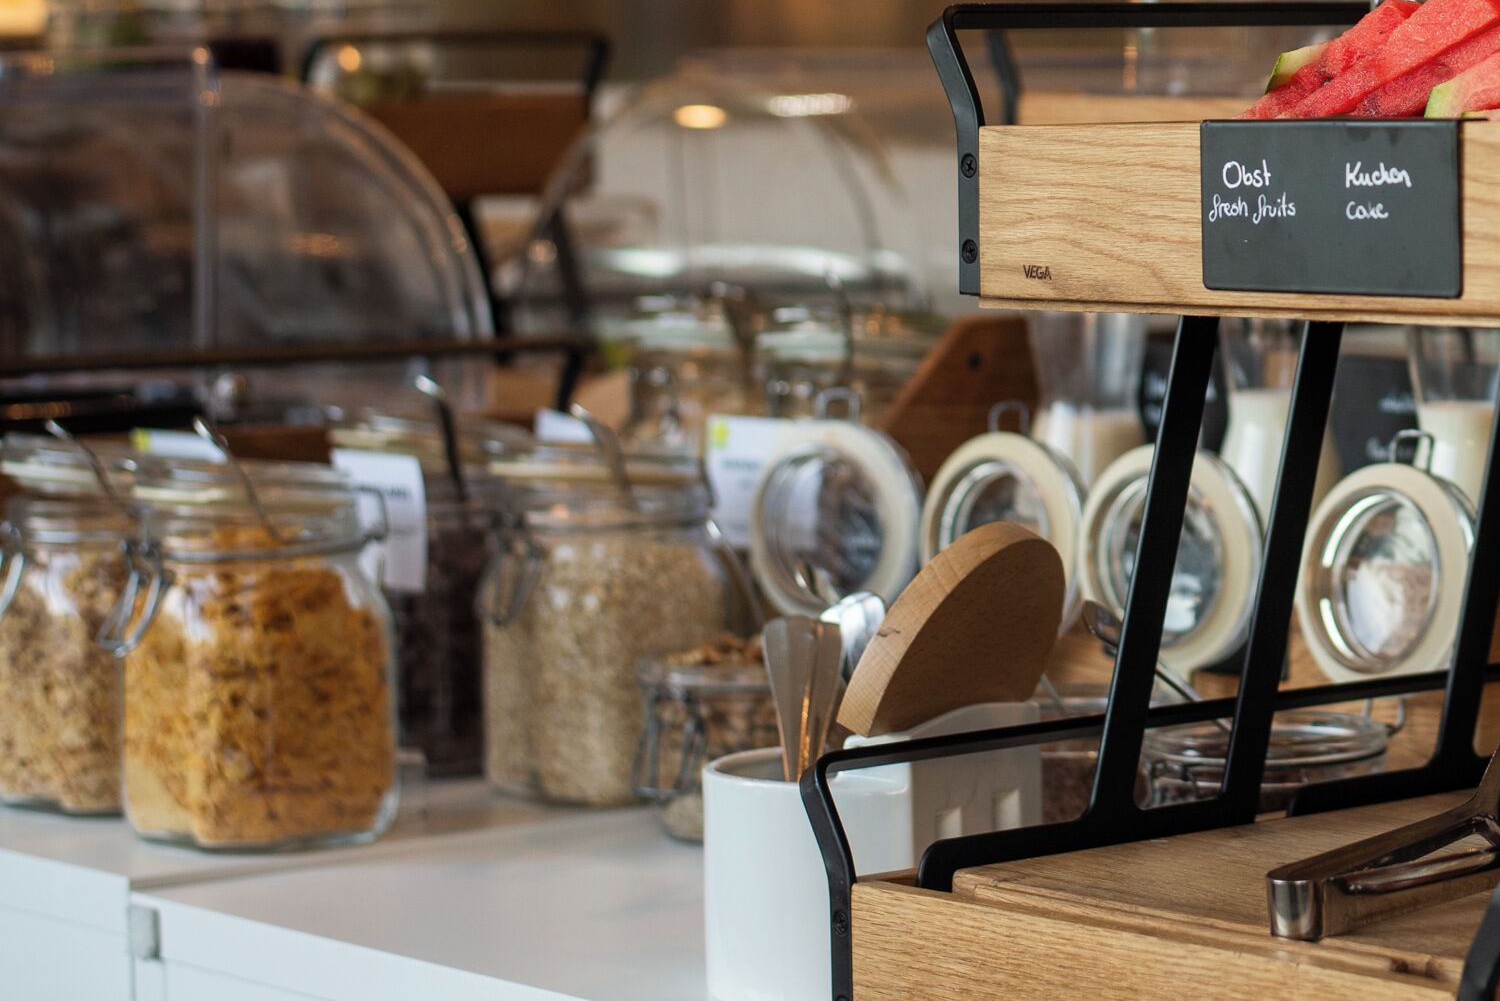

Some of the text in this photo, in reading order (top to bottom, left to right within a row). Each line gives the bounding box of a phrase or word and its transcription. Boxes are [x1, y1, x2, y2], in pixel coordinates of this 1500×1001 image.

[1222, 159, 1272, 189] Obst
[1208, 191, 1296, 225] fresh fruits
[1022, 264, 1052, 280] VEGA
